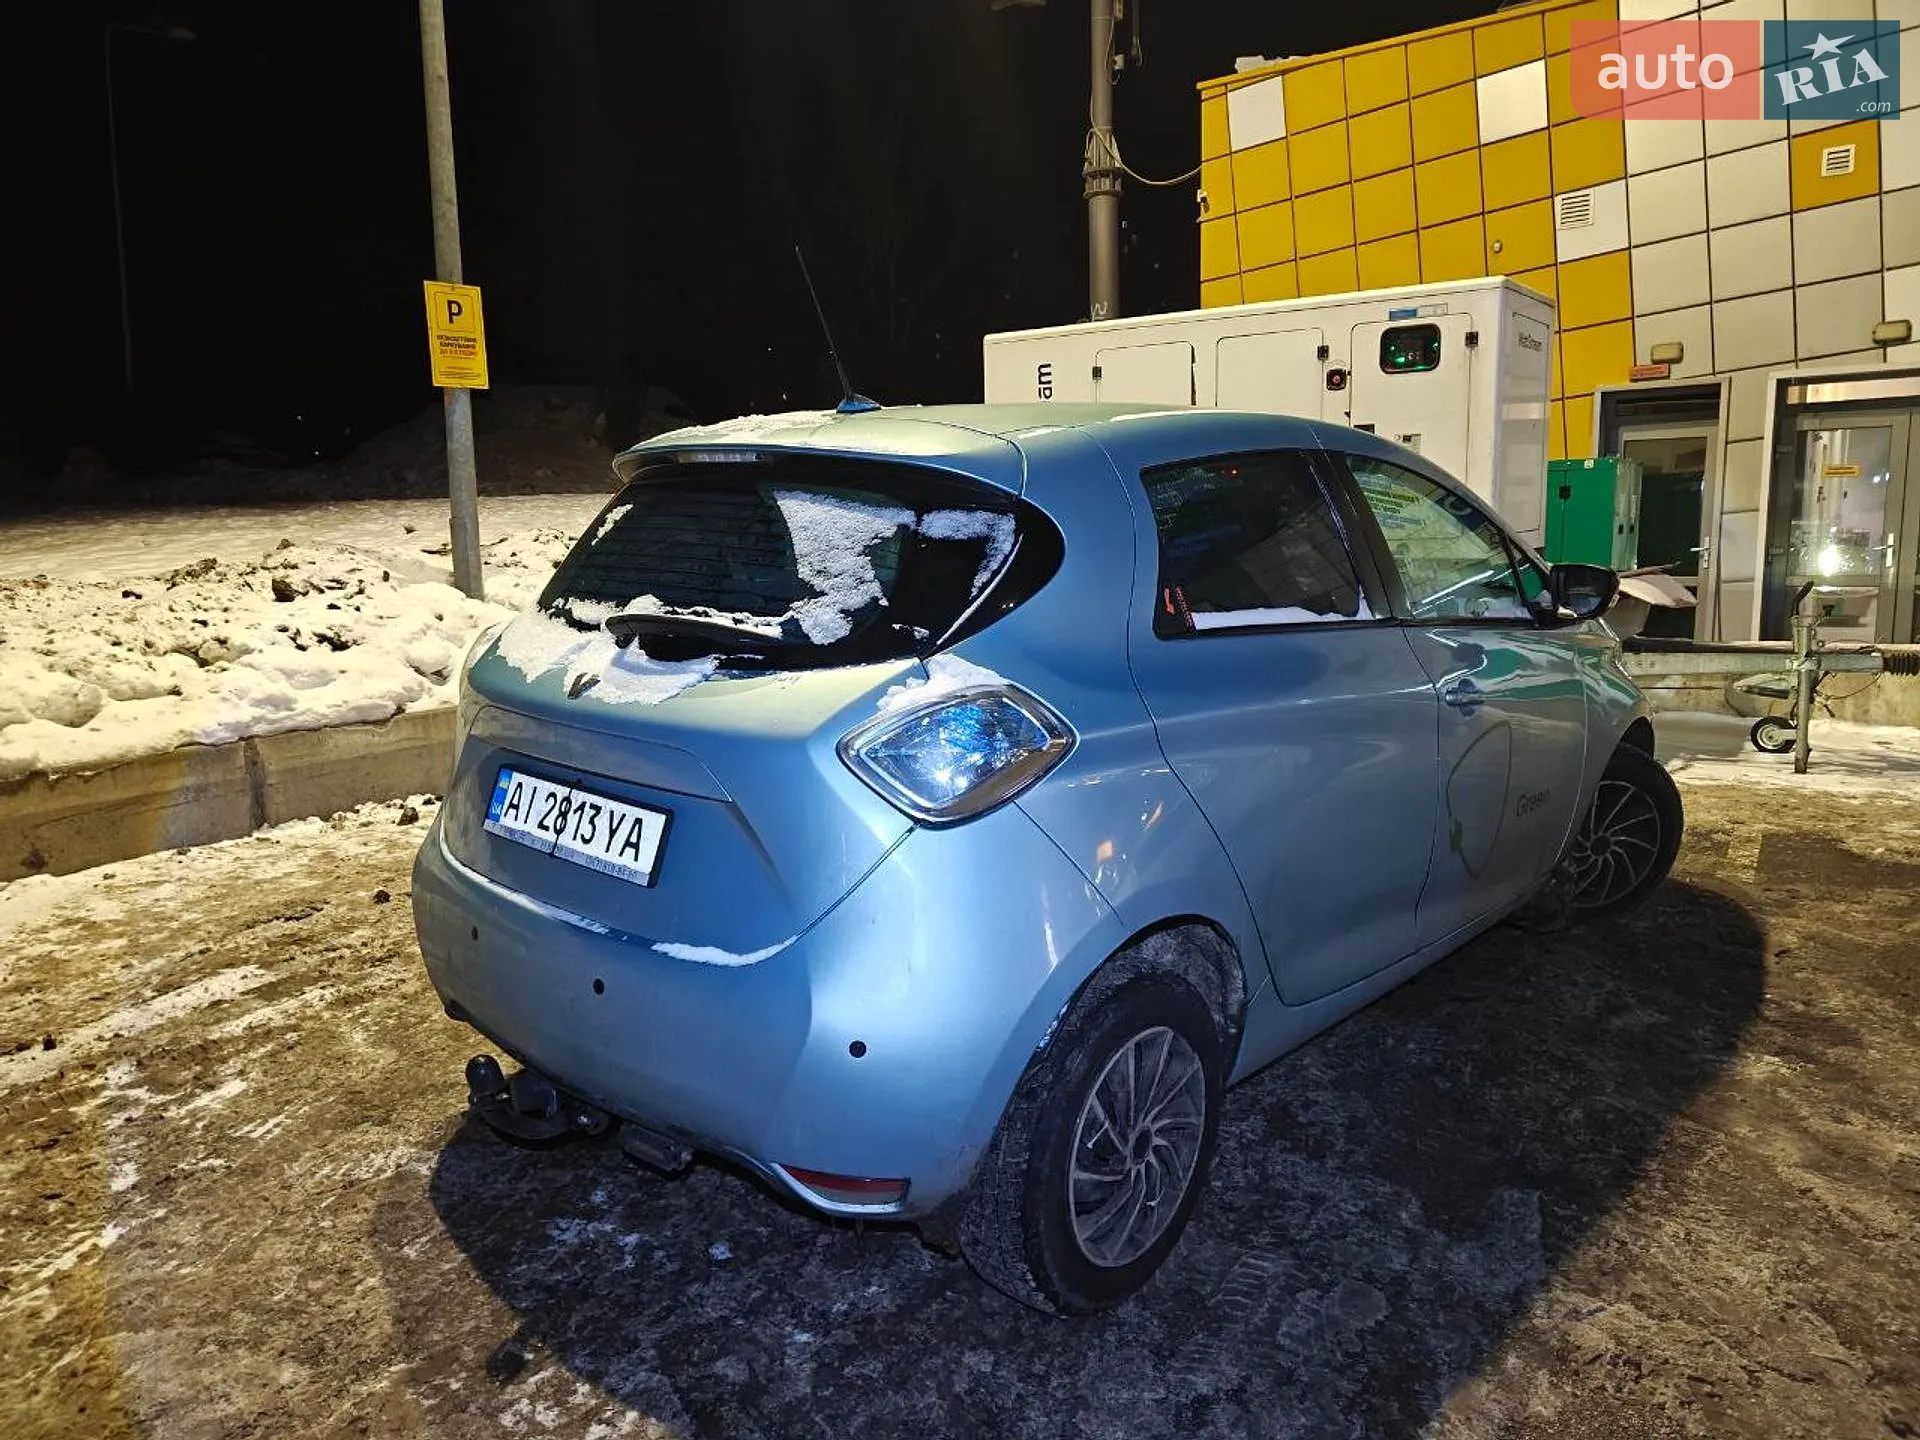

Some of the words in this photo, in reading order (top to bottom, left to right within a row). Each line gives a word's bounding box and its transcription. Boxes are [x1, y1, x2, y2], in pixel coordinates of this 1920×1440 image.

[447, 299, 463, 324] P
[537, 791, 602, 845] 2813
[605, 810, 643, 863] YA
